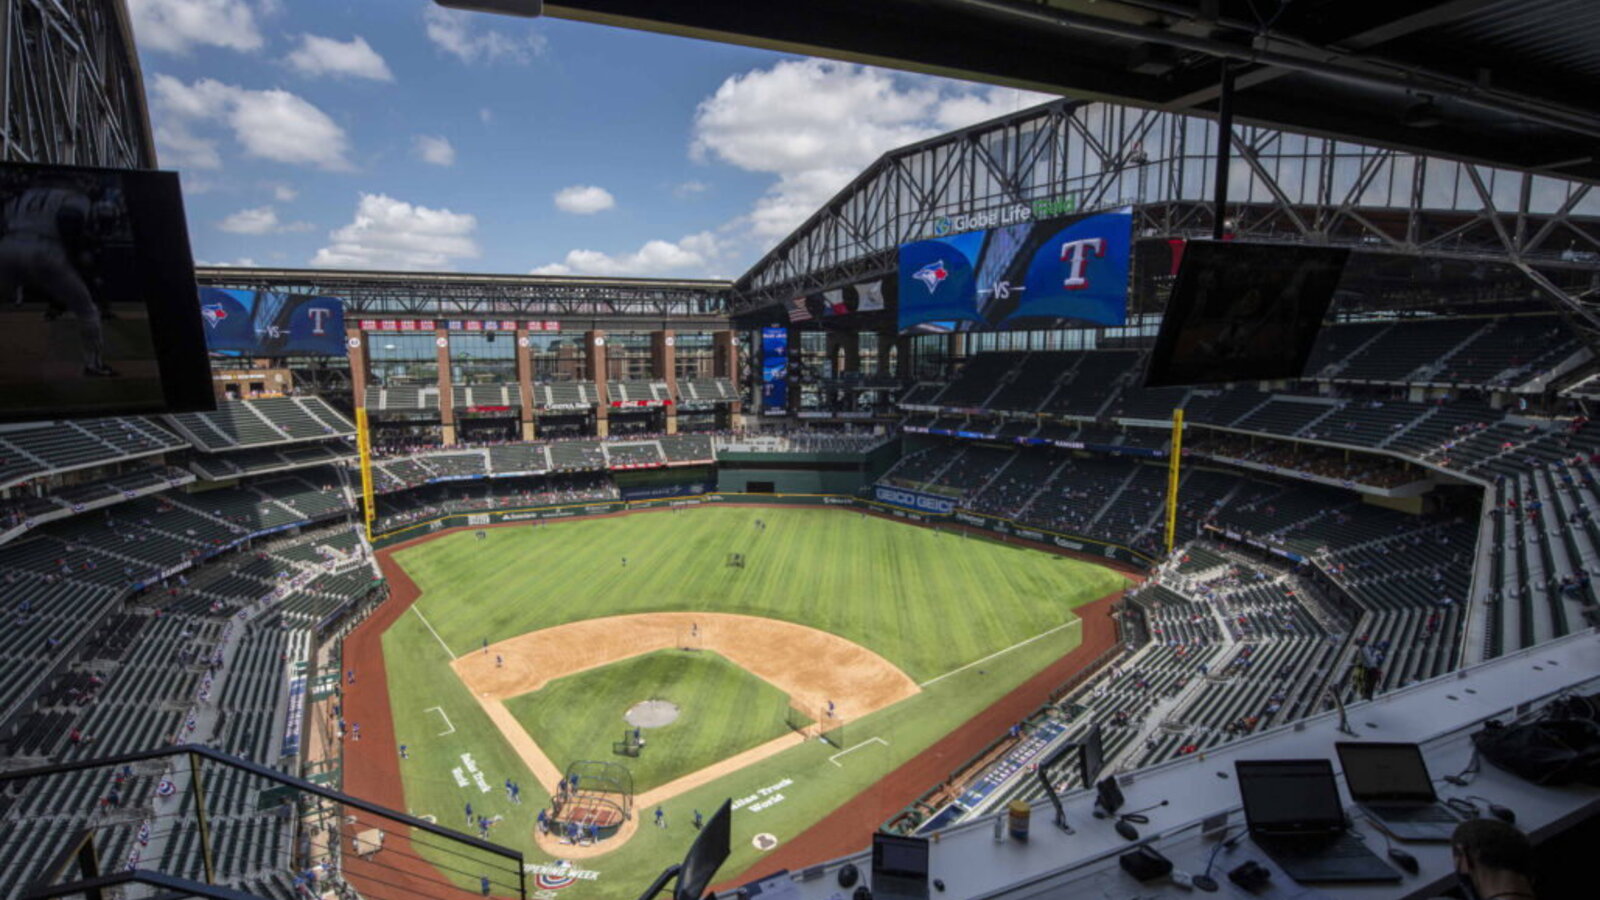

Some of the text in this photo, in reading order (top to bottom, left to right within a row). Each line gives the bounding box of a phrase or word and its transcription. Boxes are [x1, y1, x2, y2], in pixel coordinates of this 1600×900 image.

[955, 211, 997, 231] Globe
[1001, 203, 1031, 223] Life
[1061, 238, 1106, 290] T
[993, 281, 1010, 299] VS
[307, 308, 332, 336] T
[876, 487, 915, 504] GEICO
[748, 793, 785, 812] World
